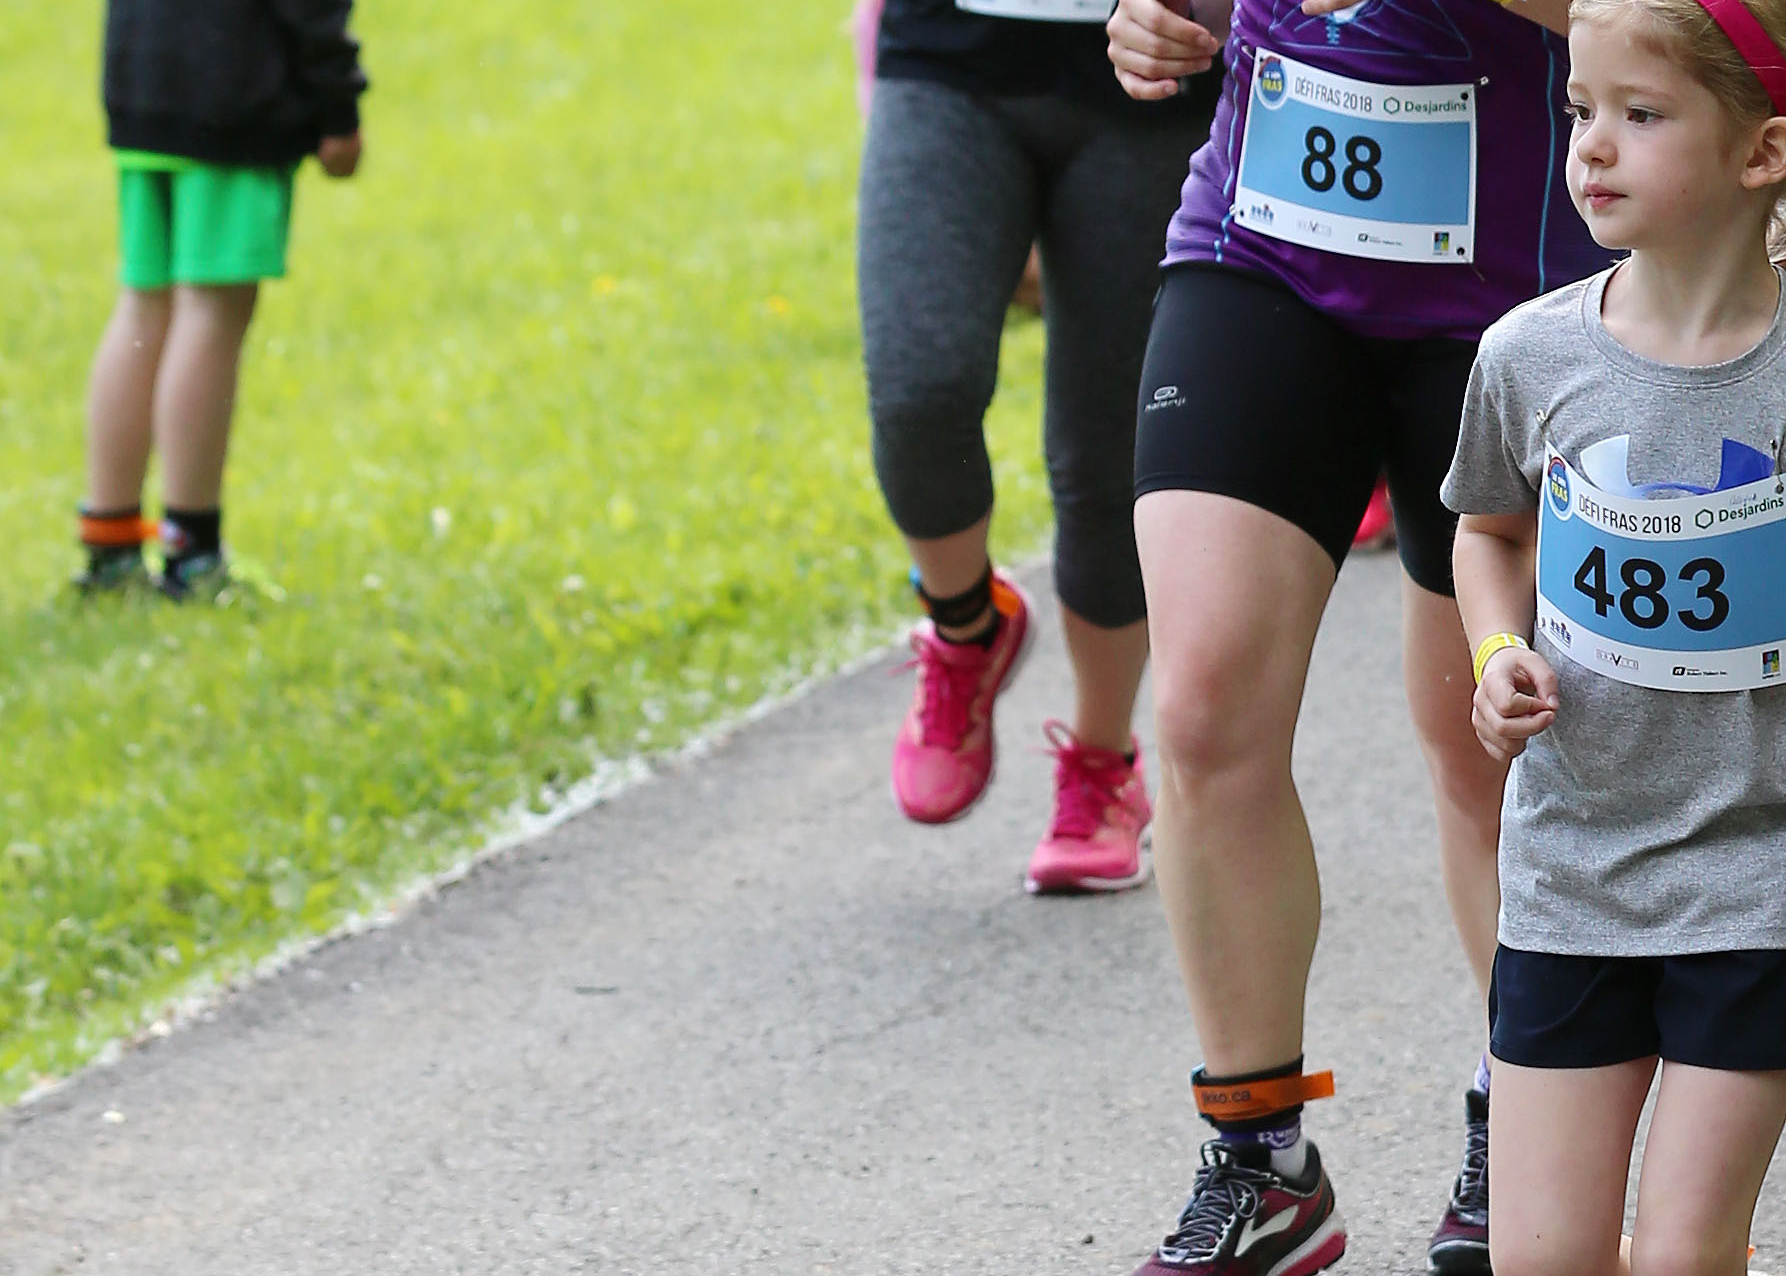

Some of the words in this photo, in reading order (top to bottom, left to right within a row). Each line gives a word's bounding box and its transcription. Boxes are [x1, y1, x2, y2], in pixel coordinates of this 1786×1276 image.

[1314, 83, 1341, 106] FRAS
[1343, 91, 1373, 113] 2018
[1404, 100, 1467, 115] Desjardins
[1301, 126, 1383, 201] 88
[1579, 492, 1600, 522] DÉFI
[1602, 507, 1638, 532] FRAS
[1642, 515, 1681, 534] 2018
[1718, 497, 1784, 522] Desjardins
[1574, 545, 1730, 632] 483
